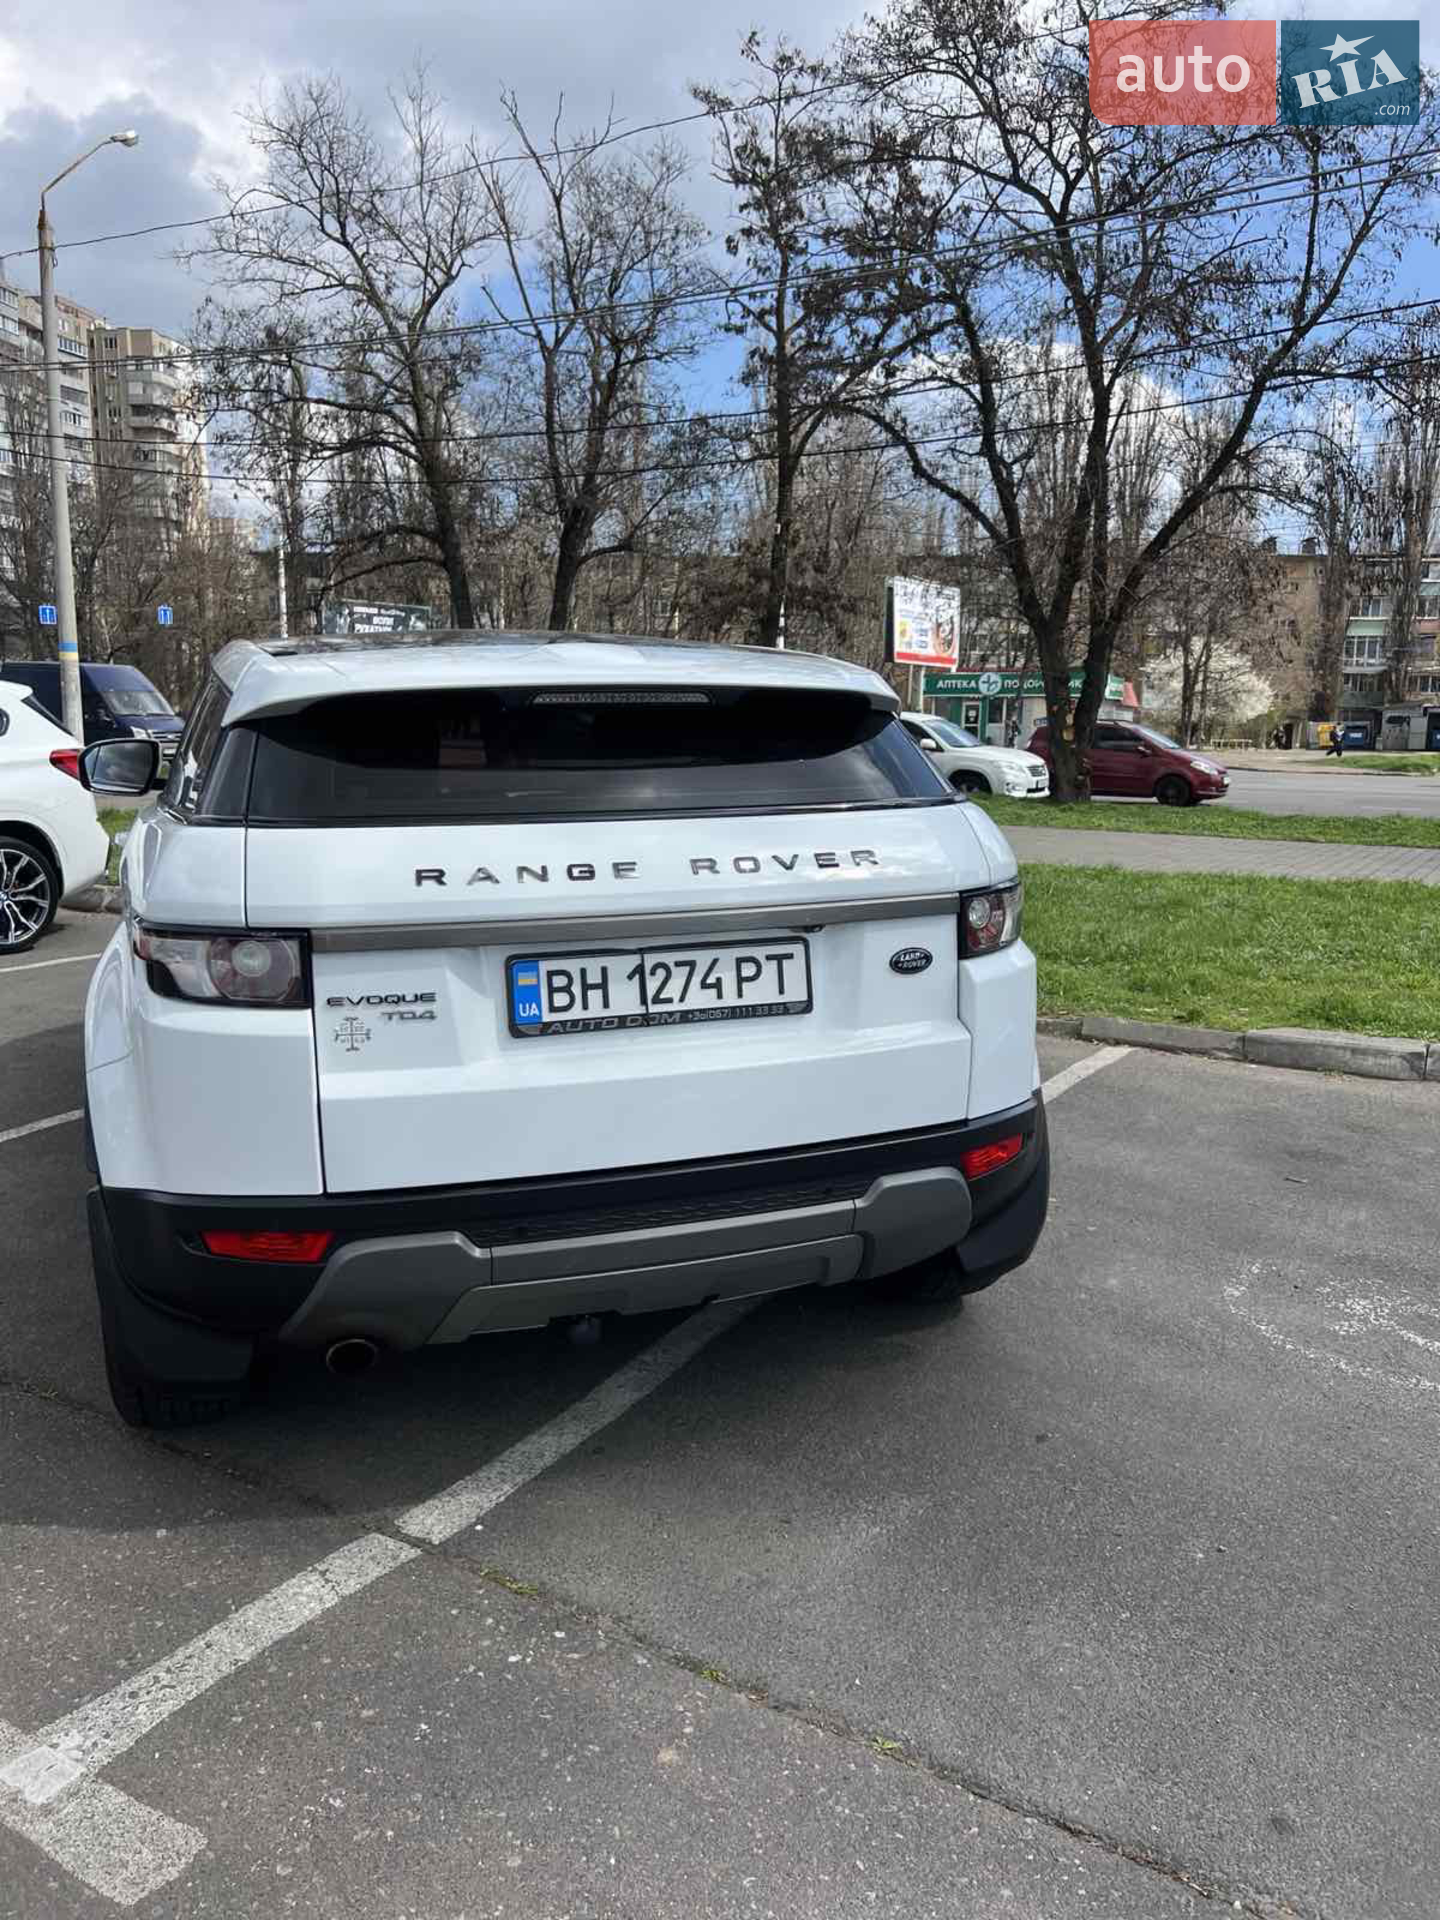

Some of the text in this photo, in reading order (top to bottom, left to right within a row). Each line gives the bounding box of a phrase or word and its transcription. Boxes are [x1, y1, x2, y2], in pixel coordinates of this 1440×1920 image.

[936, 680, 976, 689] АПТЕКА
[415, 850, 879, 887] RANGE ROVER
[546, 952, 794, 1013] BH 1274 PT
[326, 992, 437, 1008] EVOQUE
[381, 1010, 437, 1021] TD4
[518, 1003, 540, 1018] UA
[547, 1017, 619, 1035] AUTO
